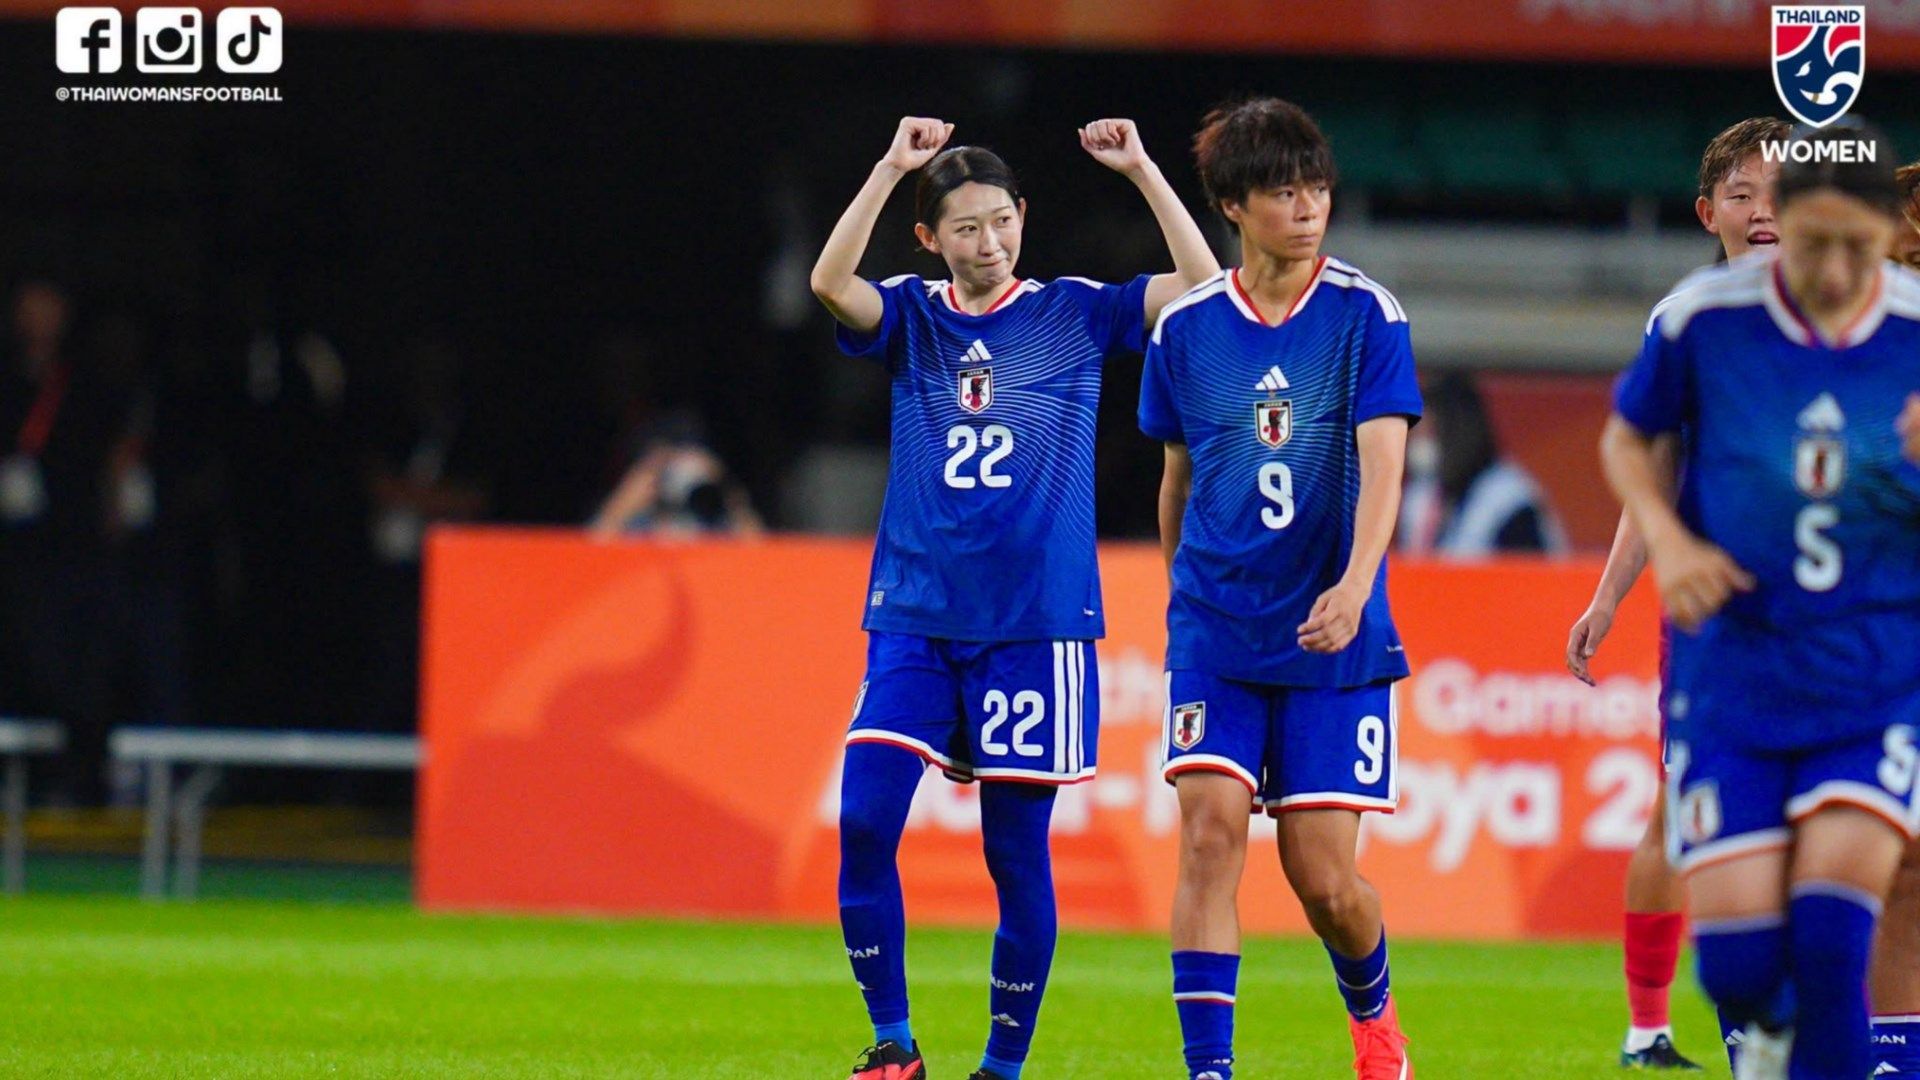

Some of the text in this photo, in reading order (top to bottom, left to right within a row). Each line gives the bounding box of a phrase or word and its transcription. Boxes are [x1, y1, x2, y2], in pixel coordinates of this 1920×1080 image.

[944, 424, 1014, 489] 22
[1258, 462, 1295, 530] 9
[980, 689, 1045, 757] 22
[1354, 715, 1385, 785] 9
[846, 945, 879, 958] PAN
[990, 974, 1035, 992] APAN
[1871, 1035, 1906, 1045] PAN
